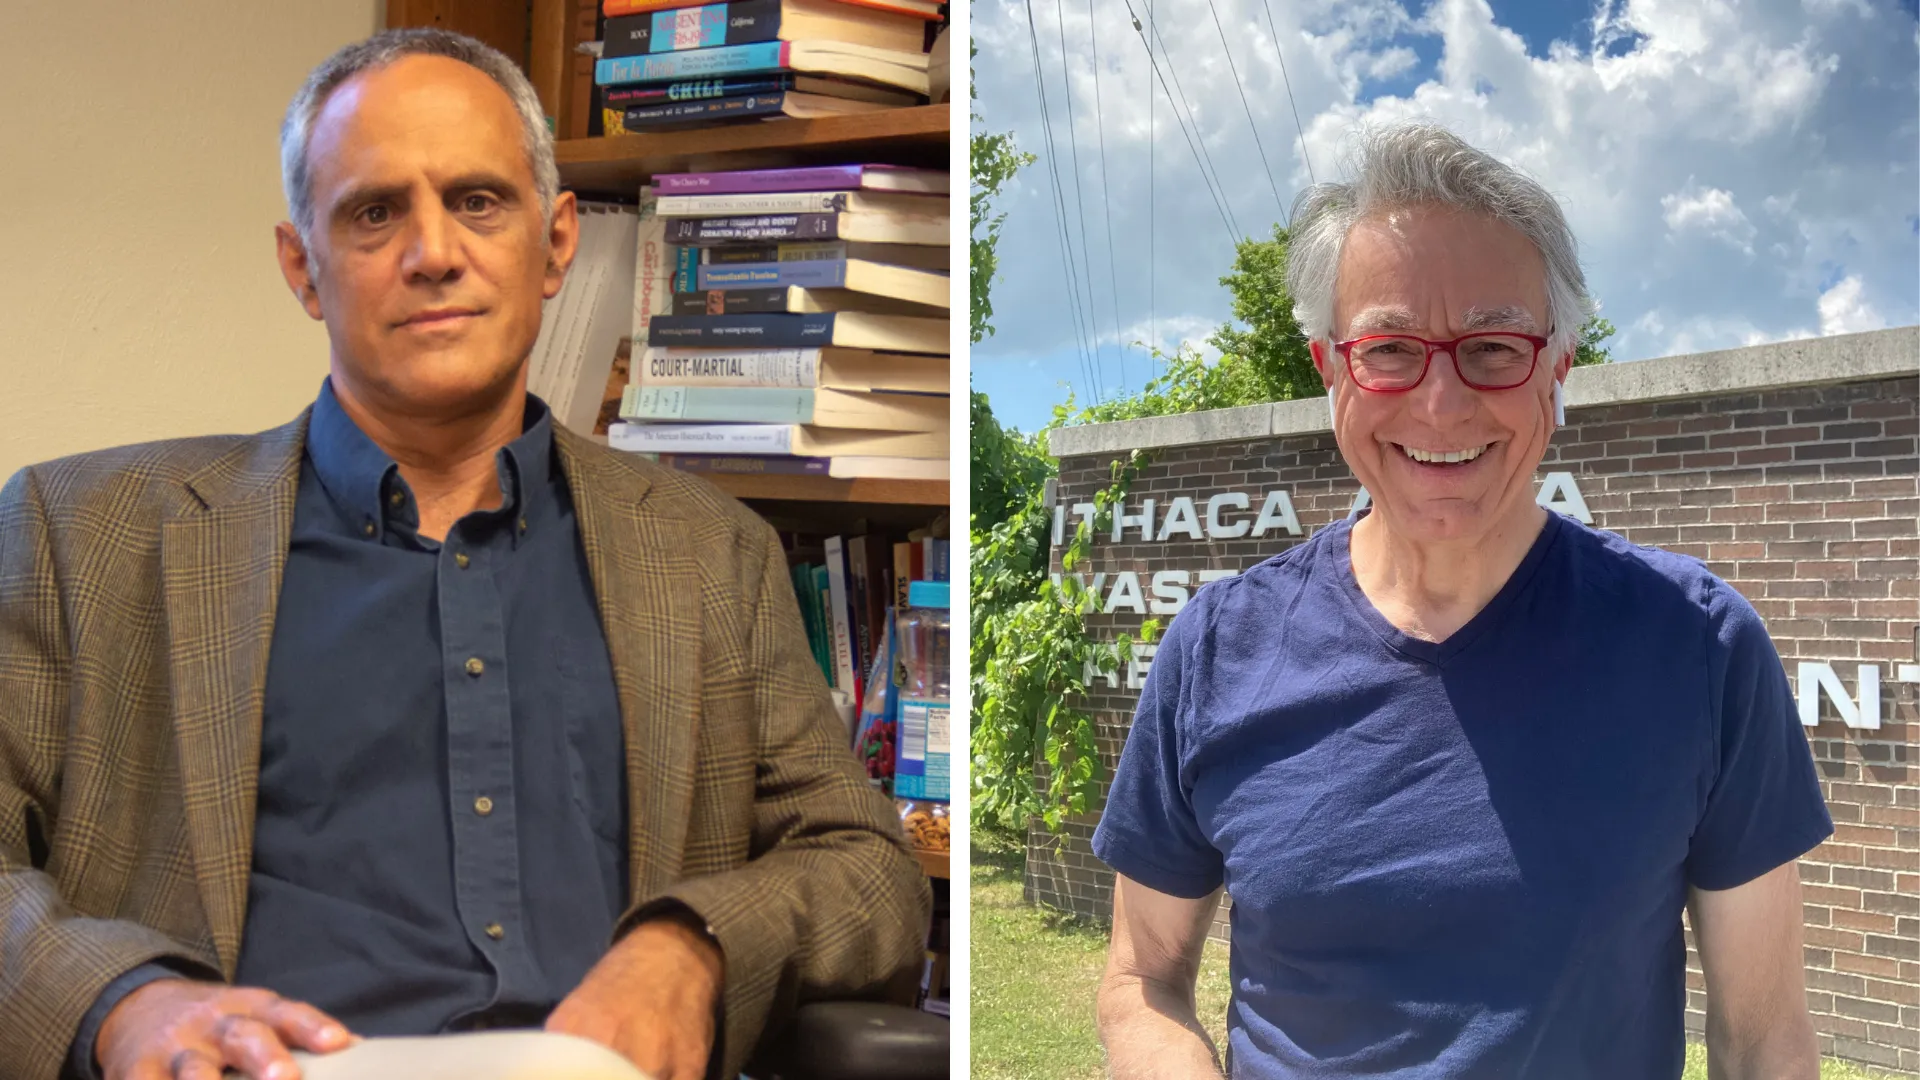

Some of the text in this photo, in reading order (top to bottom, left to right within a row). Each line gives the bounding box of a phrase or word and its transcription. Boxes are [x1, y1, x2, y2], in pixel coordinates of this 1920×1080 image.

[656, 9, 725, 32] ARGENTINA
[668, 79, 724, 100] CHILE
[640, 241, 657, 328] Caribbean
[650, 358, 745, 377] COURT-MARTIAL
[644, 430, 655, 441] The
[1051, 490, 1304, 545] ITHACA
